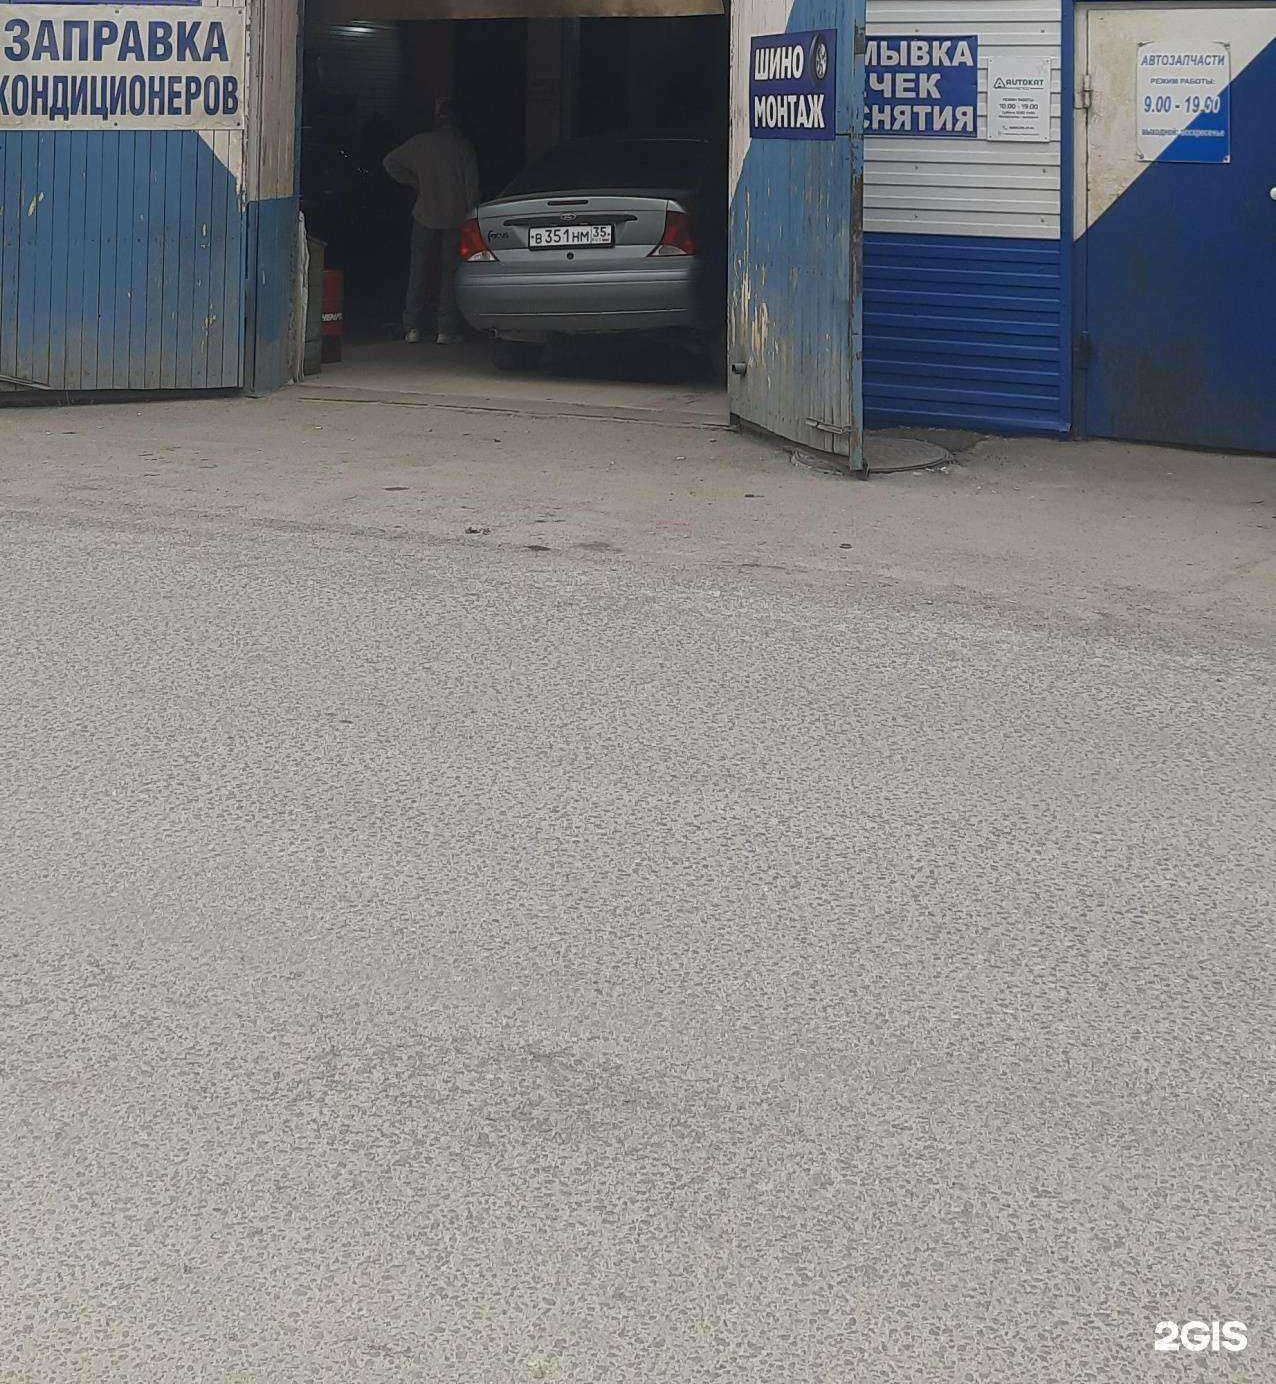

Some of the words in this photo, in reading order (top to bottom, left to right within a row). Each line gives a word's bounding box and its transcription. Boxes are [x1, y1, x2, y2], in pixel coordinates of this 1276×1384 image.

[4, 18, 229, 62] ЗАПРАВКА
[754, 44, 805, 81] ШИНО
[1141, 54, 1226, 67] АВТОЗАПЧАСТИ
[0, 74, 239, 121] КОНДИЦИОНЕРОВ
[864, 72, 942, 99] ЧЕК
[754, 94, 826, 129] МОНТАЖ
[1144, 95, 1172, 113] 9.00
[1184, 95, 1221, 114] 19.00
